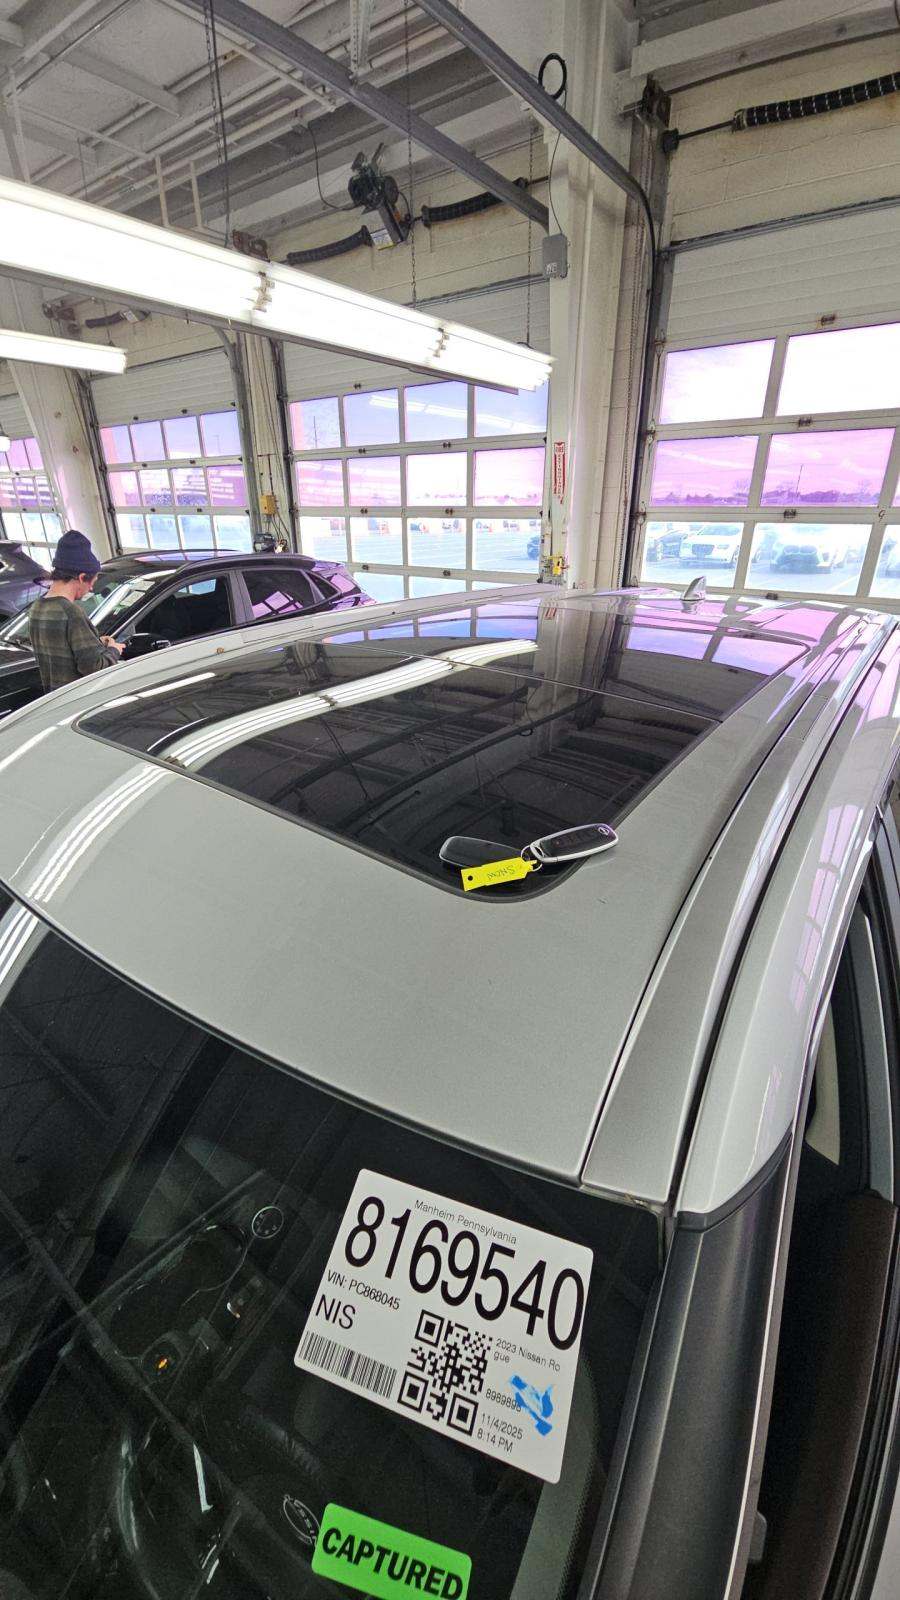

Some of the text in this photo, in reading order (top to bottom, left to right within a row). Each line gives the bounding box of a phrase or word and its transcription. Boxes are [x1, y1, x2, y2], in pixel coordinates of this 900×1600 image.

[414, 1199, 517, 1245] Manheim Pennsylvania
[327, 1269, 401, 1310] VIN: PC868045
[345, 1196, 585, 1350] 8169540
[315, 1294, 356, 1330] NIS
[493, 1350, 510, 1363] gue
[496, 1338, 561, 1372] 2023 Nissan Ro
[476, 1427, 514, 1454] 8:14 PM
[481, 1412, 524, 1440] 11/4/2025
[322, 1527, 464, 1600] CAPTURED
